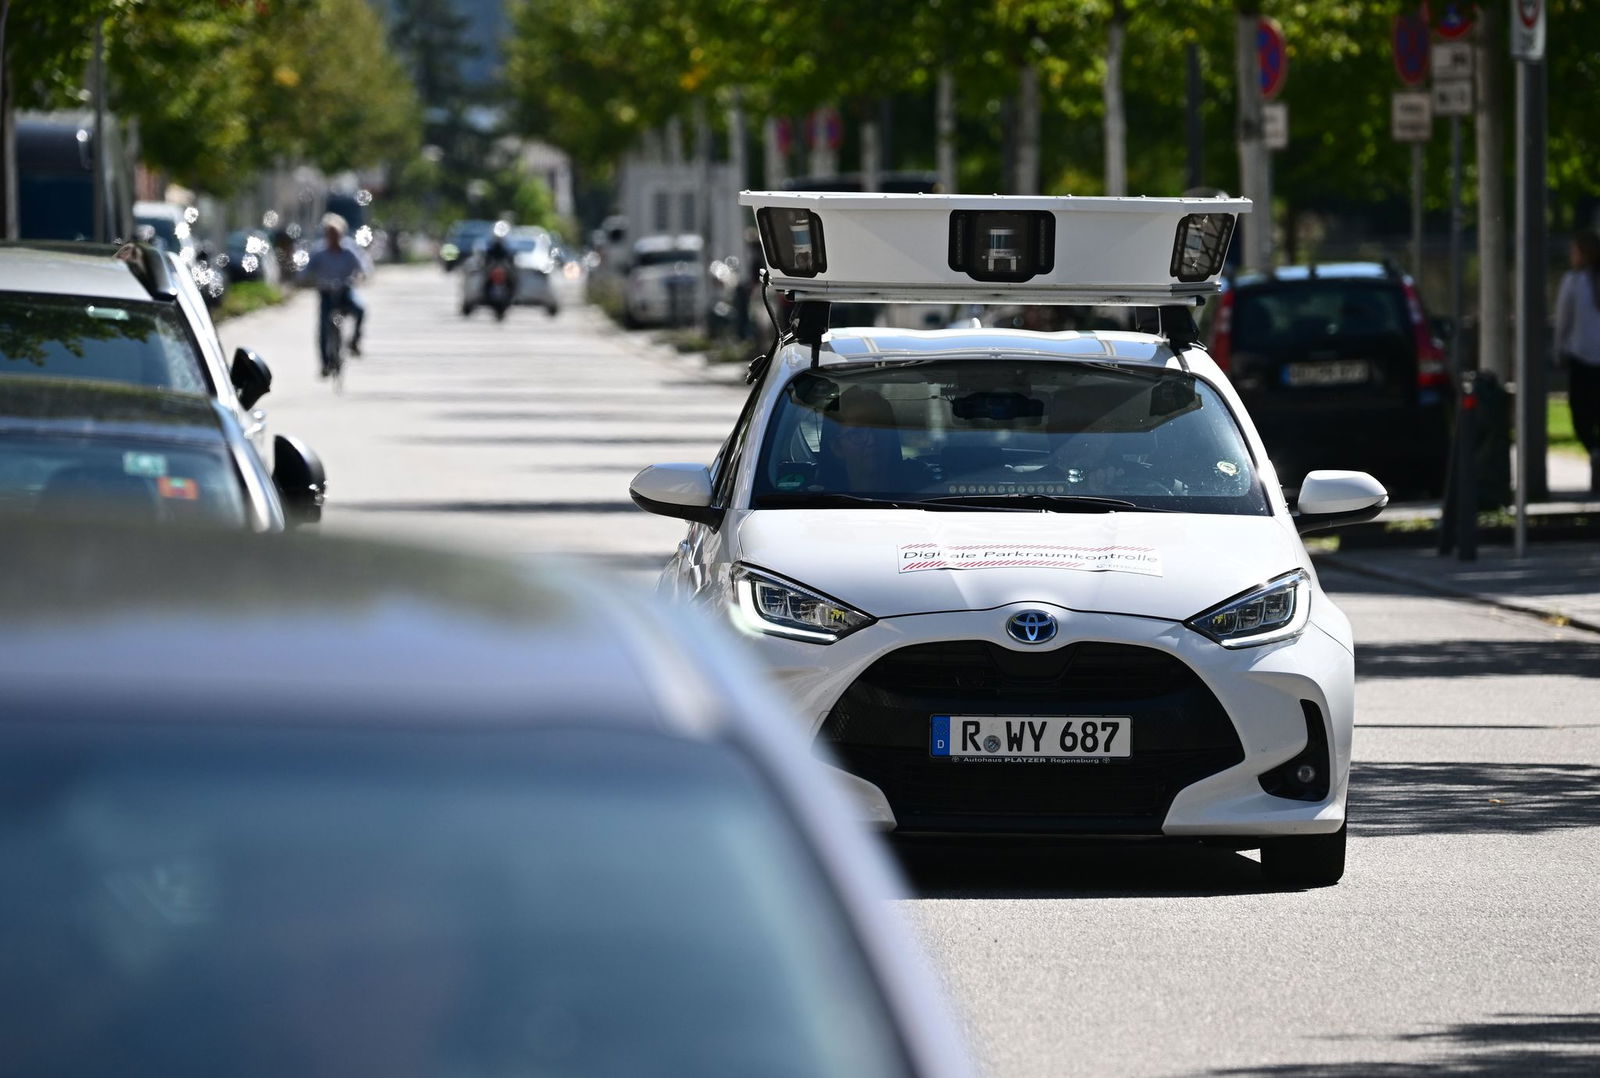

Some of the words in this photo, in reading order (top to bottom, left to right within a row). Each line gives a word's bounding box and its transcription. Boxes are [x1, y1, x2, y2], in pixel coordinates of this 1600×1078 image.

[903, 550, 977, 560] Digiale
[983, 550, 1158, 563] Parkraumkontrolle
[937, 739, 945, 749] D
[961, 720, 982, 752] R
[1005, 721, 1048, 753] WY
[1059, 721, 1120, 753] 687
[1050, 757, 1100, 765] Regensburg
